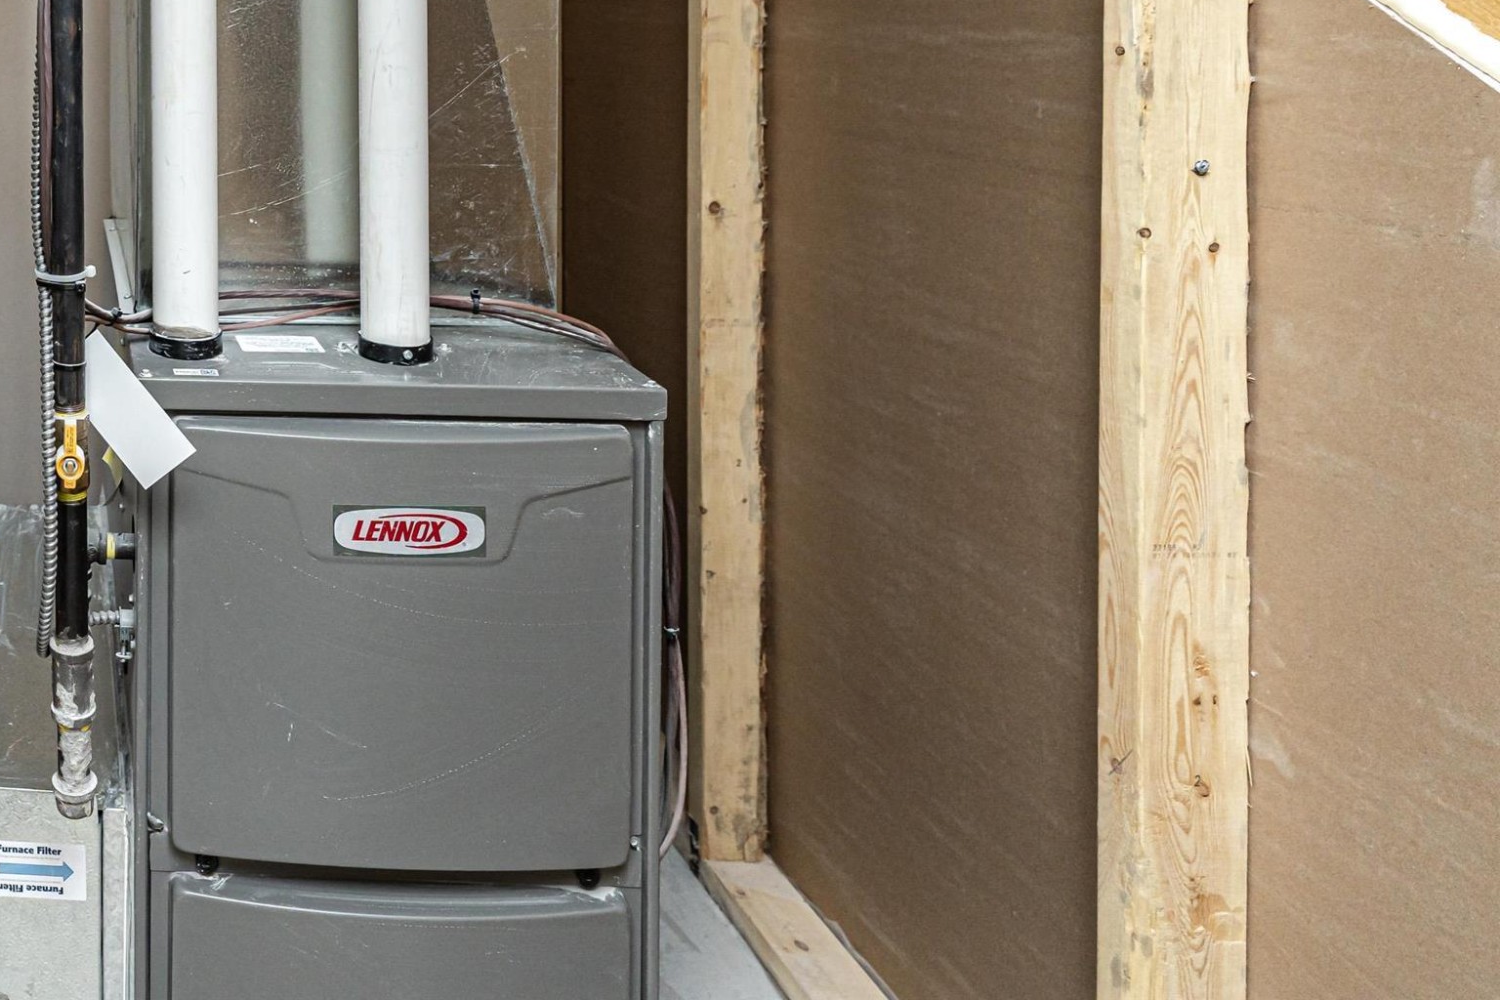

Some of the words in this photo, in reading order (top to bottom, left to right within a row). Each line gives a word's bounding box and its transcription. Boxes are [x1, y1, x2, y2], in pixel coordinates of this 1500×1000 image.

[352, 520, 446, 542] LENNOX
[37, 846, 62, 855] Filter
[0, 883, 23, 892] Filter
[26, 885, 64, 895] Furnace
